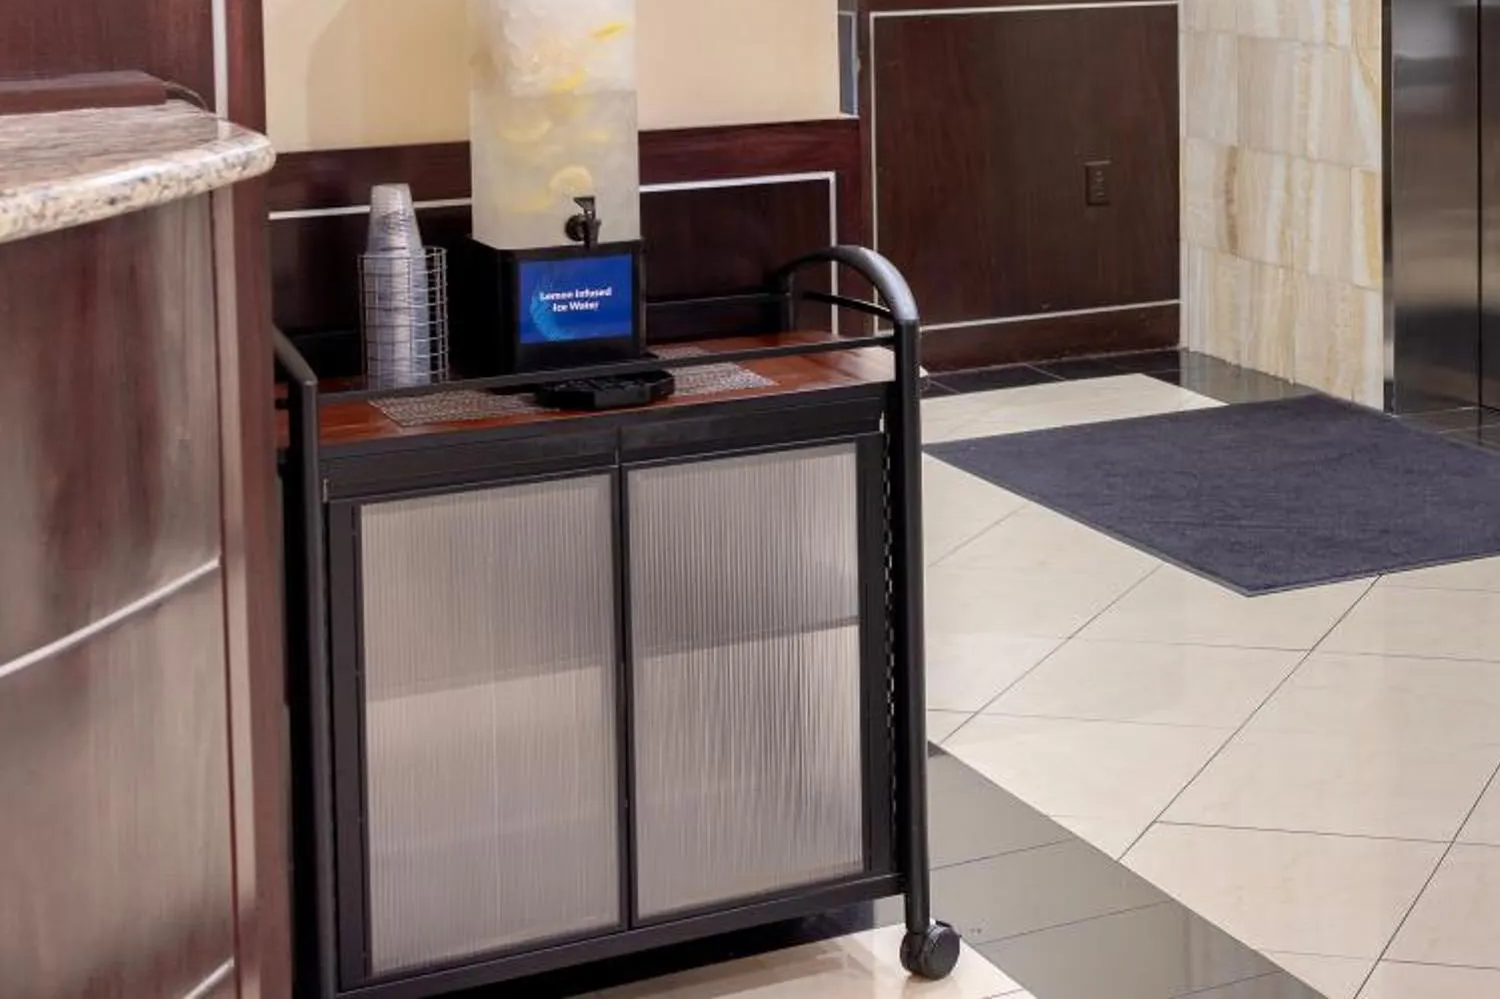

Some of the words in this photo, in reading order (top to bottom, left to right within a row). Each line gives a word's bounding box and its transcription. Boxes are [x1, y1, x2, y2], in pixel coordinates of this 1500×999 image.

[539, 291, 573, 300] Lemon
[575, 287, 612, 298] Infused
[553, 303, 568, 312] Ice
[569, 301, 599, 311] Water
